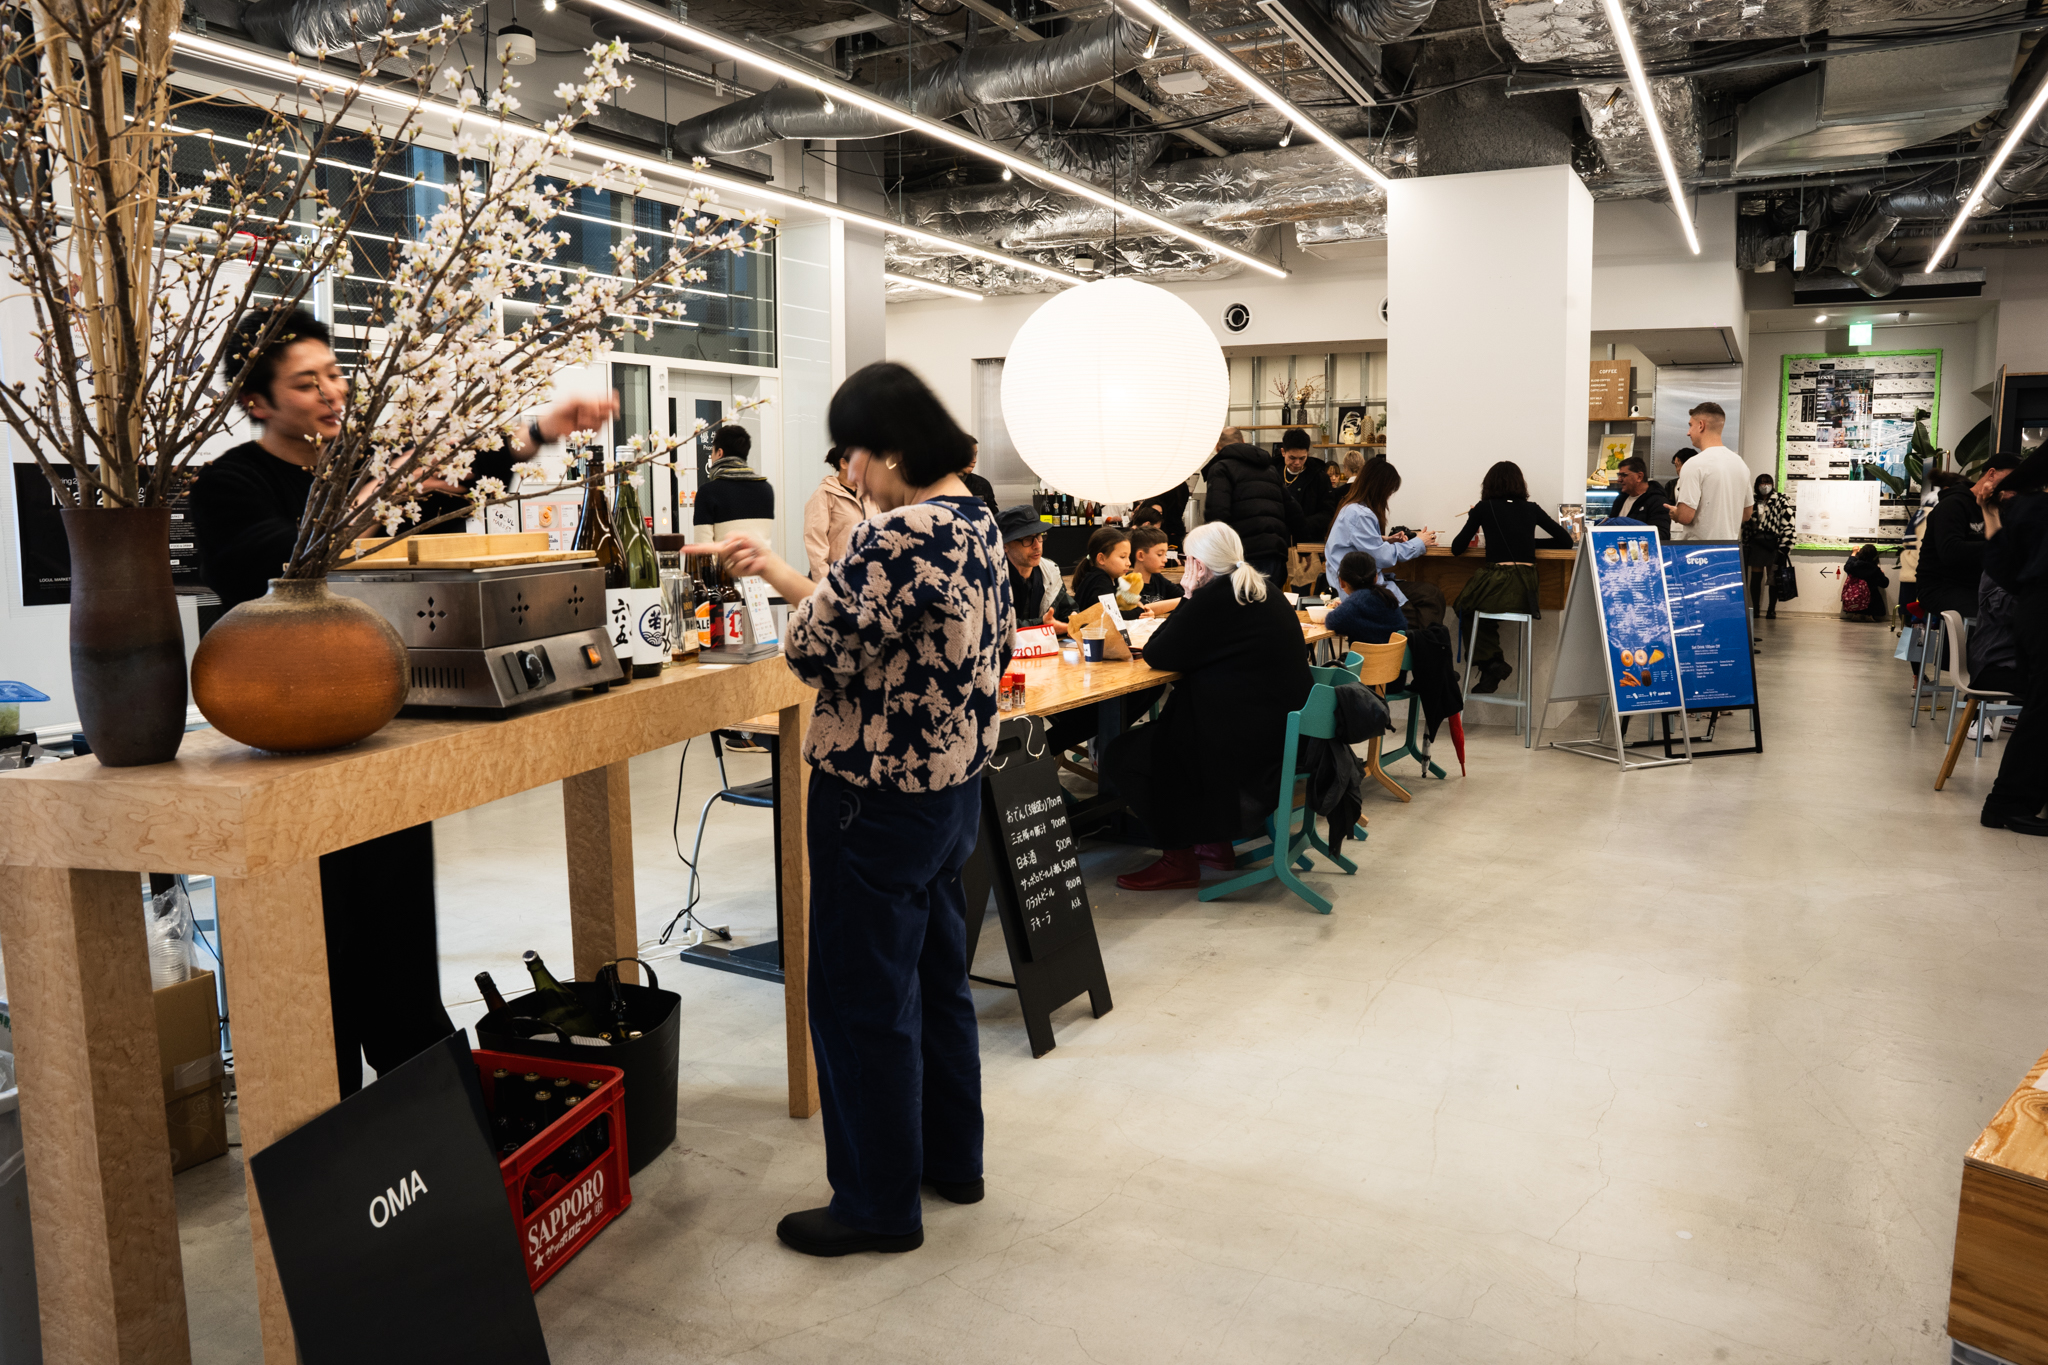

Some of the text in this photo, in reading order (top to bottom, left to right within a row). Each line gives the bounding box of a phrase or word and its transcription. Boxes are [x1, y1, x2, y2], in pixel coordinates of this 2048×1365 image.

[1857, 454, 1904, 464] LOCUL
[1686, 557, 1709, 566] crepe
[1051, 816, 1066, 829] 700円
[1016, 837, 1072, 870] 日本酒 500円
[1061, 857, 1077, 872] 500円
[1065, 876, 1082, 890] 900円
[1031, 910, 1051, 931] テキーラ
[369, 1169, 428, 1228] OMA
[528, 1169, 604, 1256] SAPPORO
[544, 1210, 593, 1260] サッポロビール
